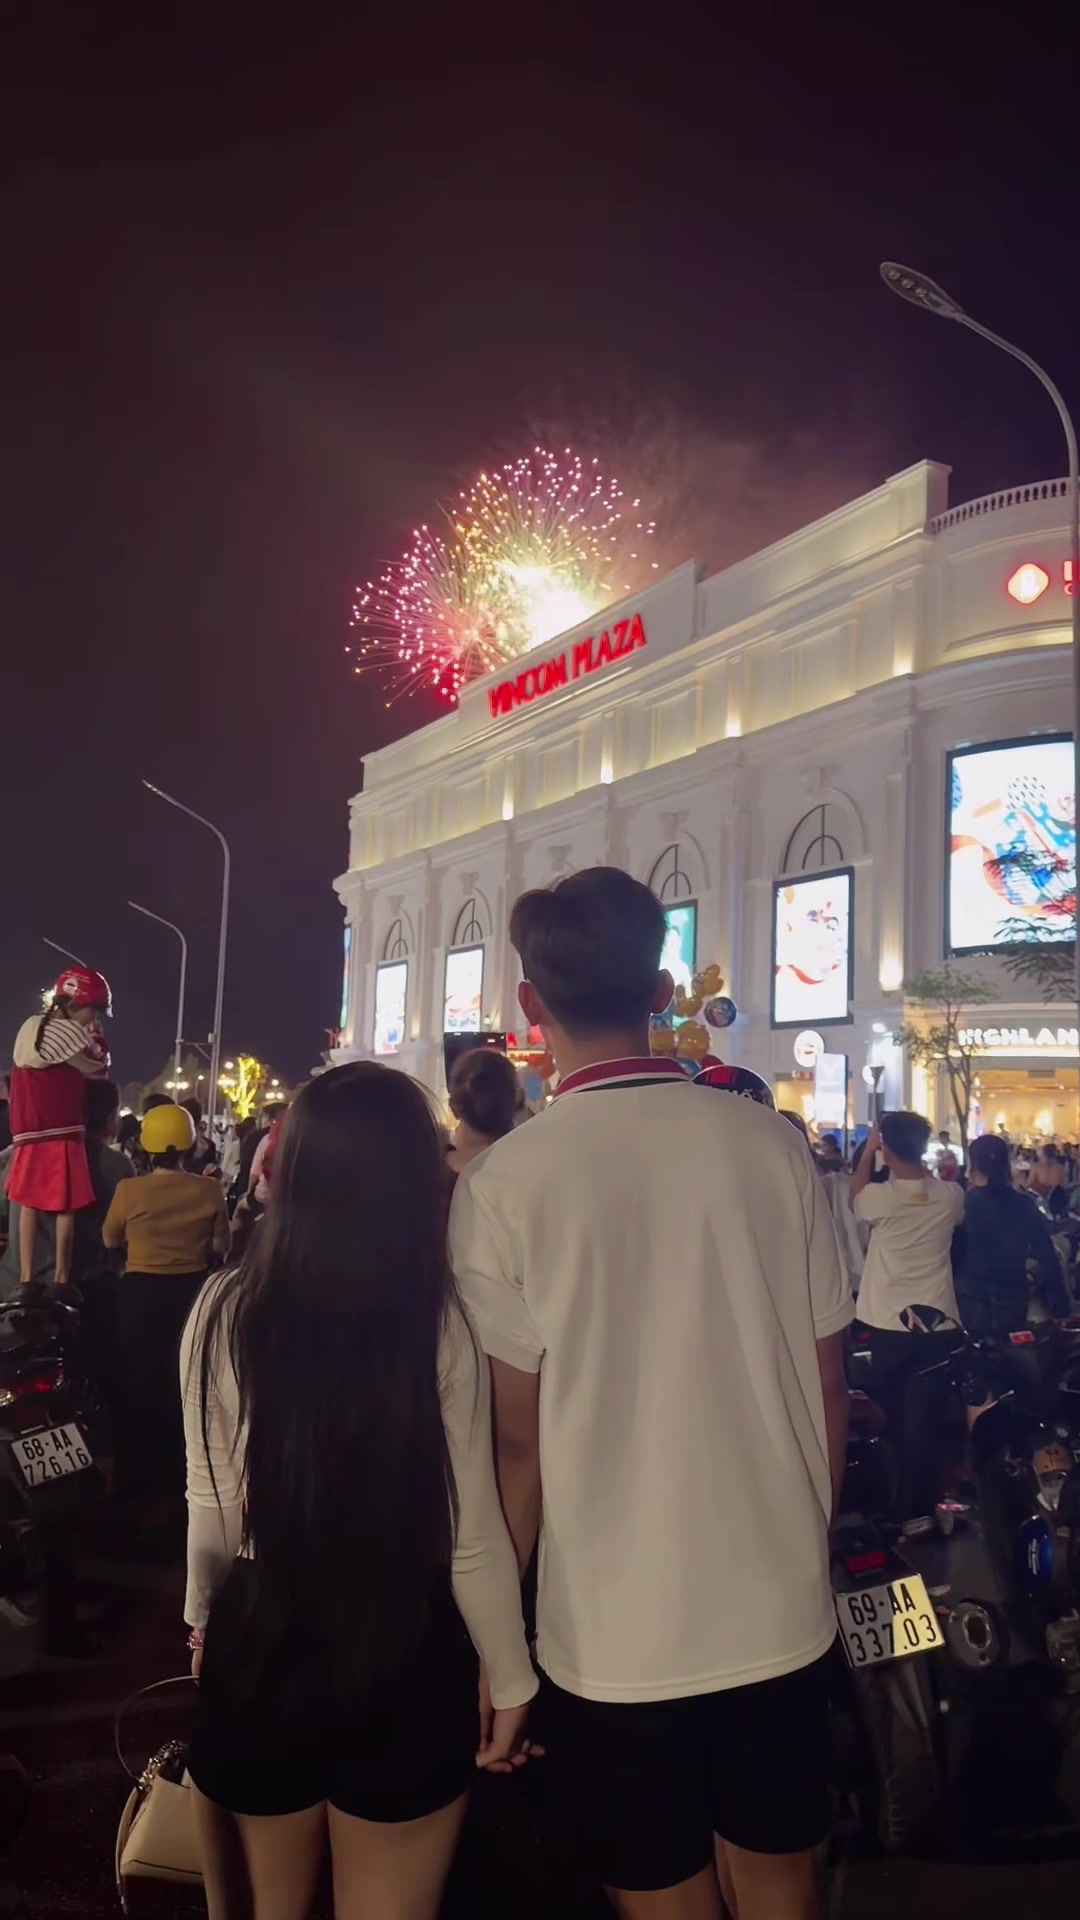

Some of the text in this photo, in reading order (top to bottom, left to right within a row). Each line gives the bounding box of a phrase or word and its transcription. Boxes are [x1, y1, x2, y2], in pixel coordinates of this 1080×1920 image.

[488, 613, 647, 718] VINCOM PLAZA
[22, 1428, 73, 1460] 68-AA
[24, 1448, 89, 1485] 726.16
[847, 1583, 916, 1625] 69-AA
[850, 1614, 936, 1662] 337.03
